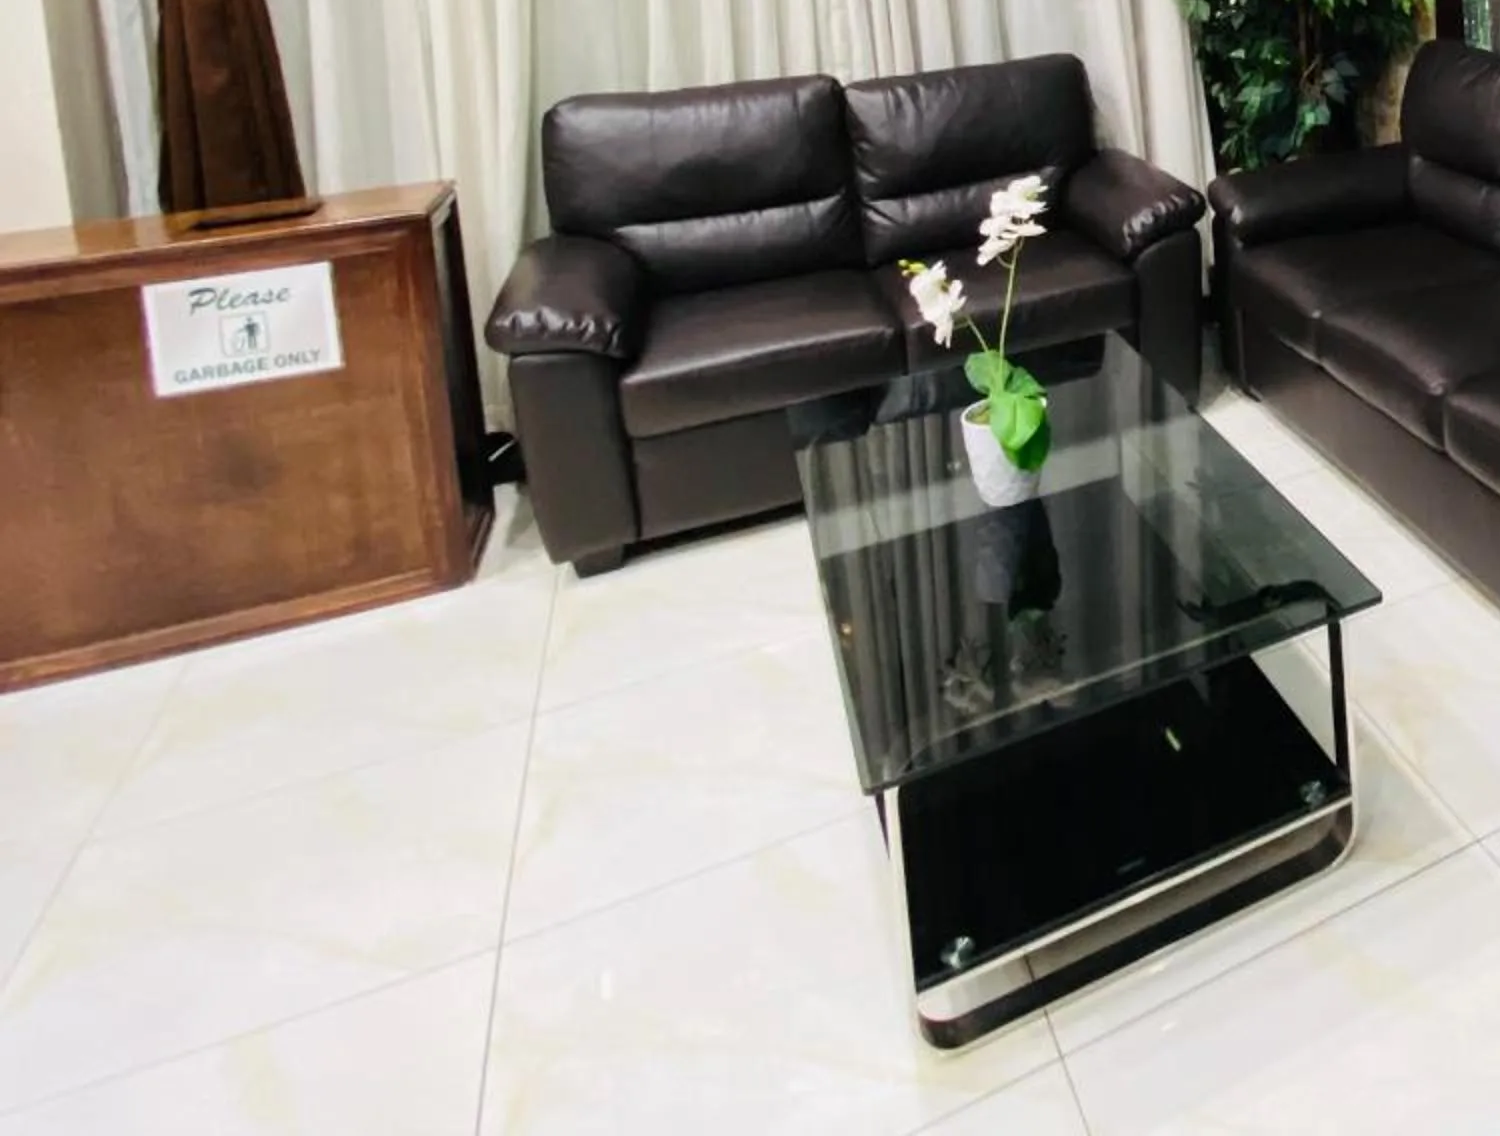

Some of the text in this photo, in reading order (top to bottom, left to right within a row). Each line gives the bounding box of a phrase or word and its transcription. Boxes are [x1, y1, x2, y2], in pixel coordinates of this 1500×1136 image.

[188, 287, 291, 316] Please
[174, 349, 321, 385] GARBAGE ONLY
